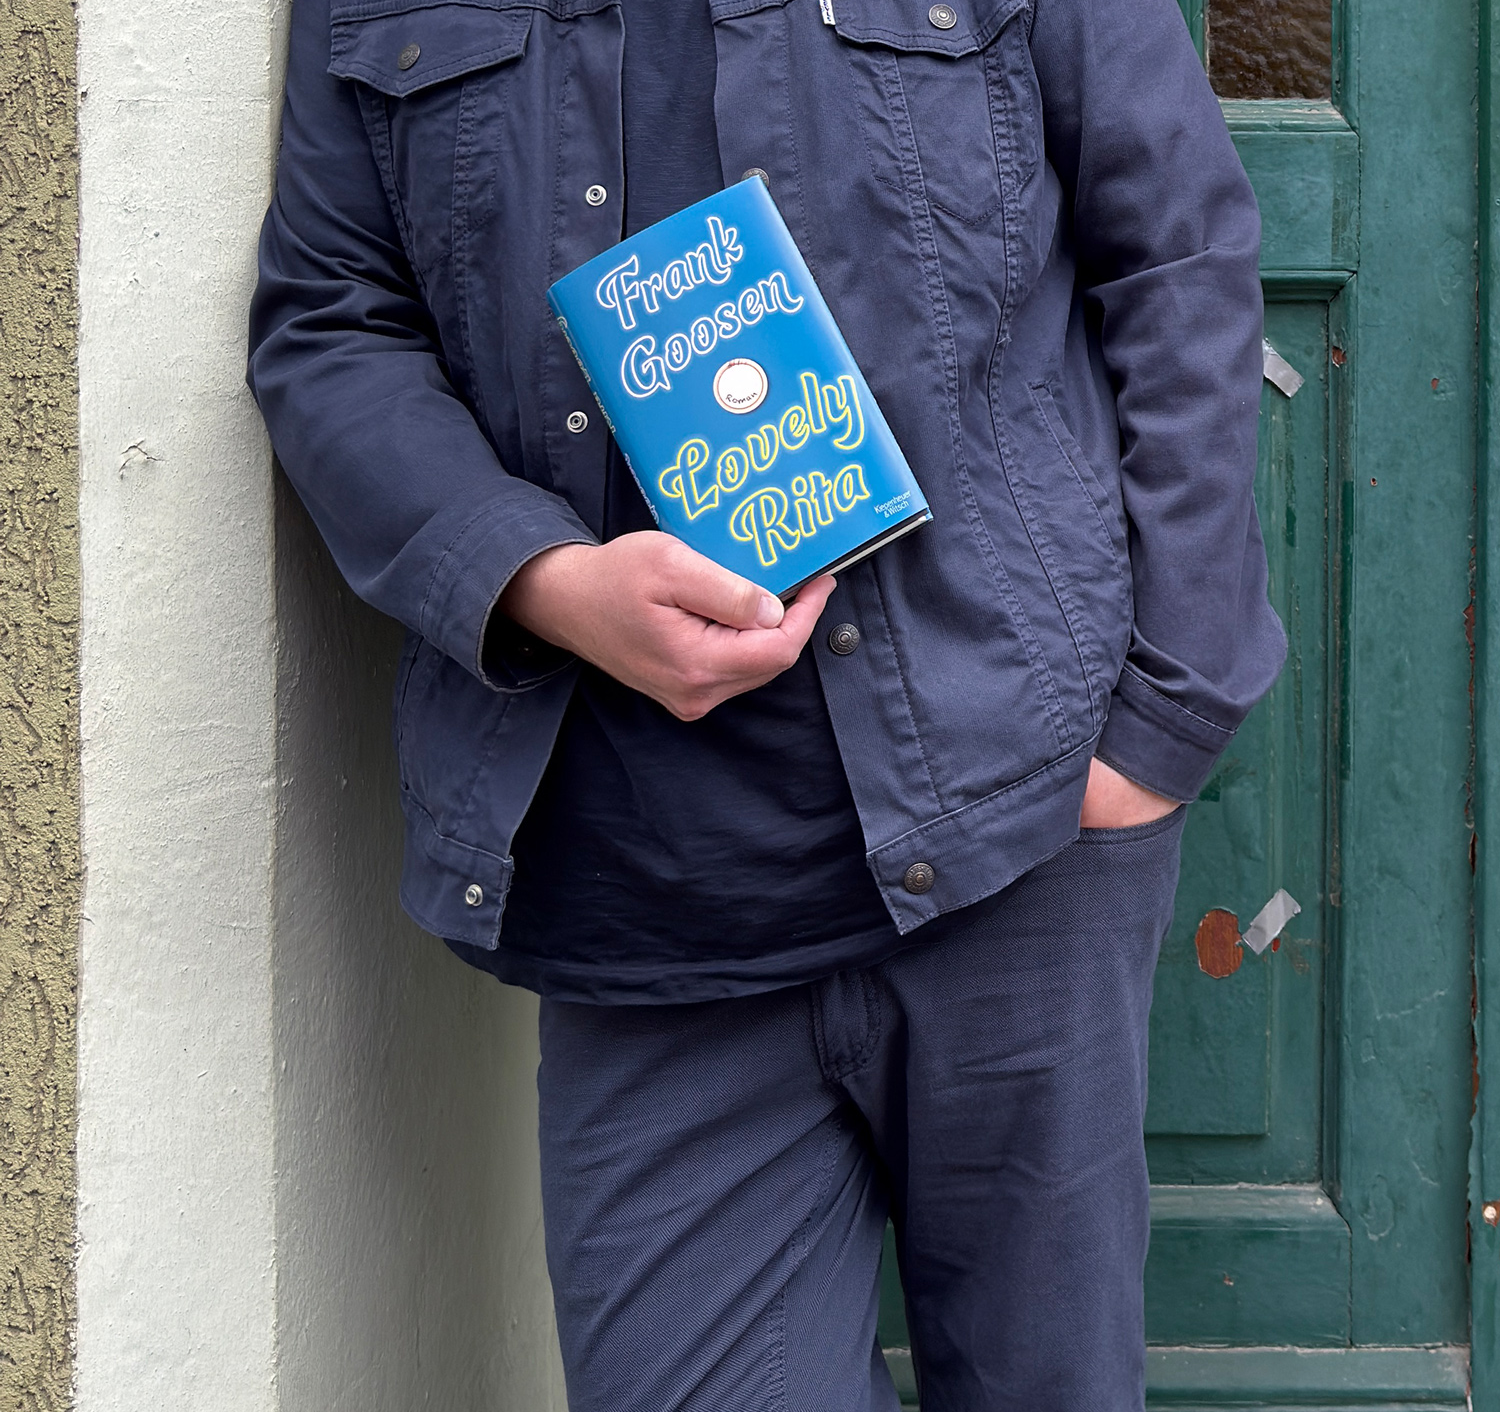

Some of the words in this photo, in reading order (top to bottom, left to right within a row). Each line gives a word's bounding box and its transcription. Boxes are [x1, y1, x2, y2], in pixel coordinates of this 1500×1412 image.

[596, 216, 745, 331] Frank
[621, 271, 805, 399] Goosen
[660, 372, 866, 520] Lovely
[726, 392, 758, 404] Roman
[729, 464, 871, 566] Rita
